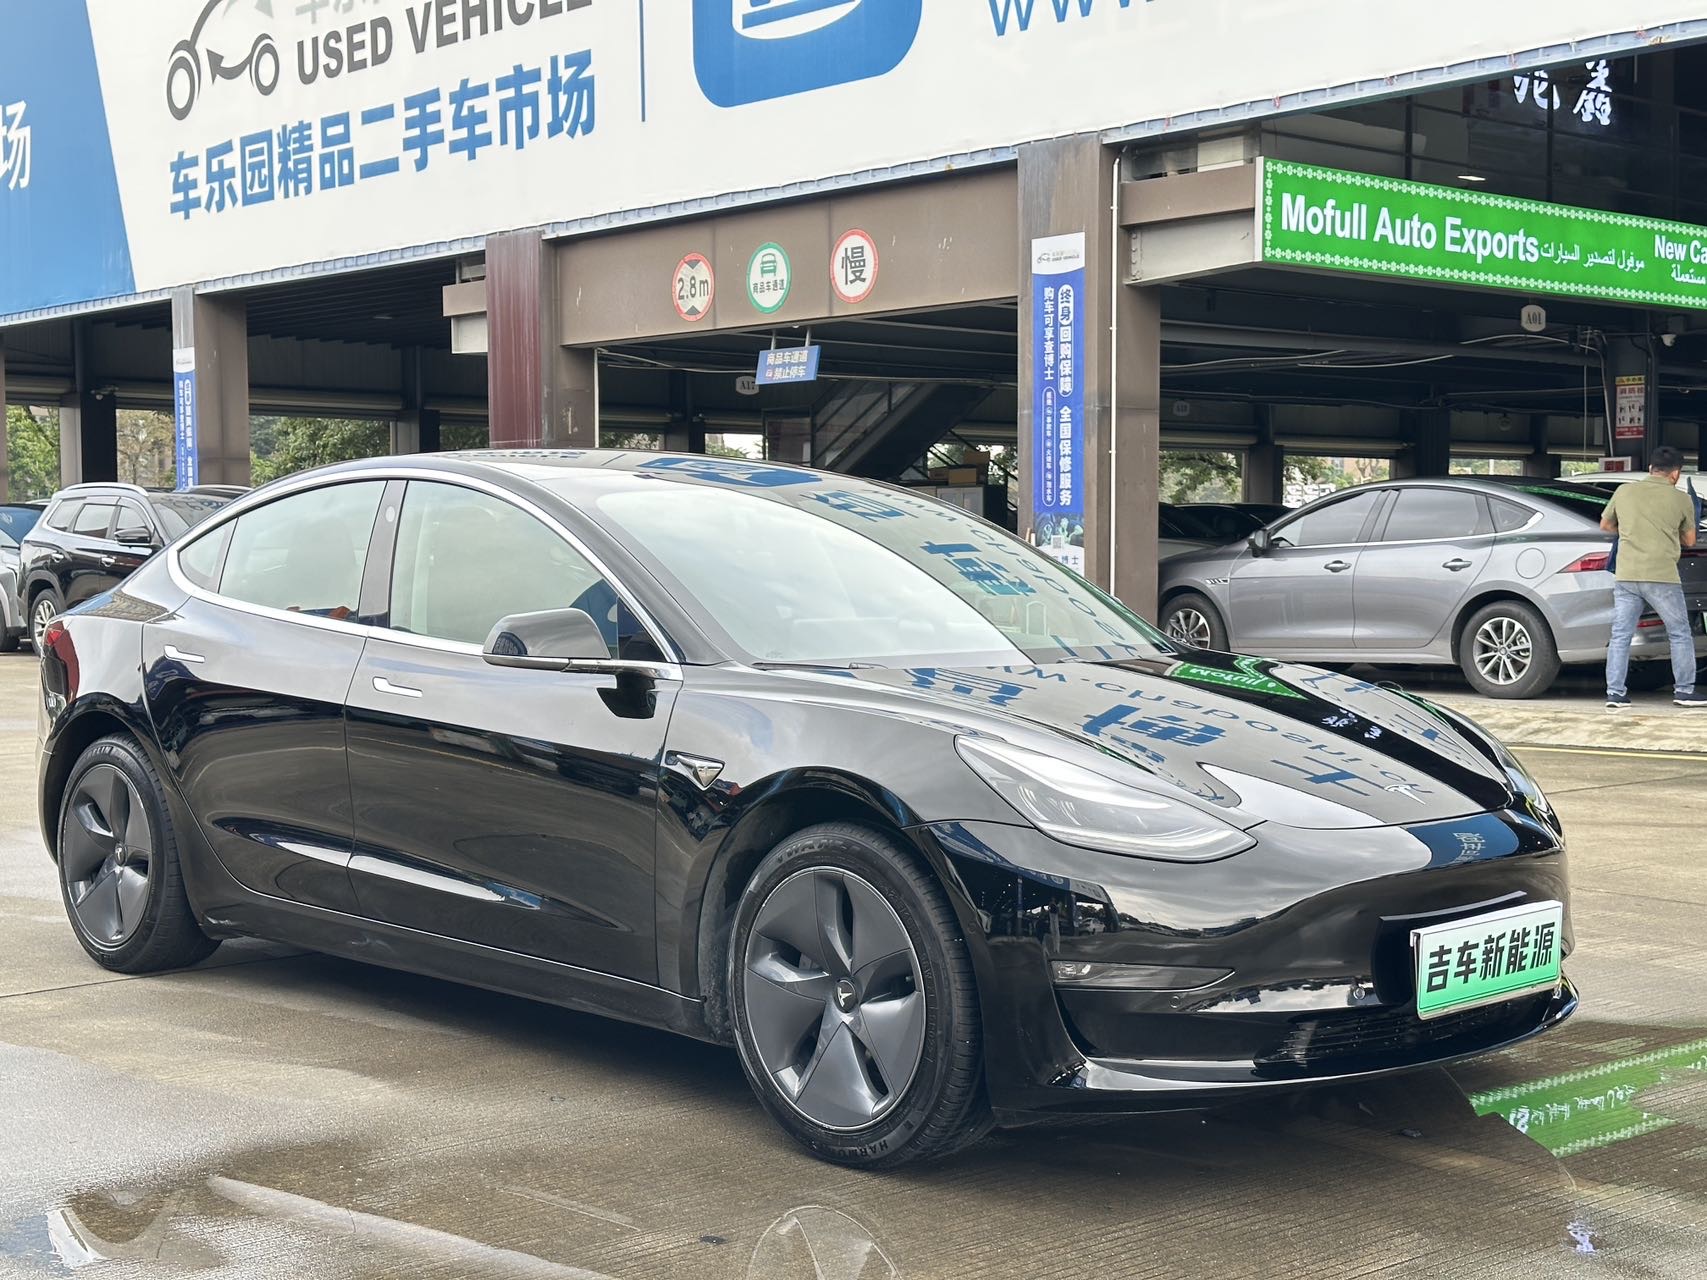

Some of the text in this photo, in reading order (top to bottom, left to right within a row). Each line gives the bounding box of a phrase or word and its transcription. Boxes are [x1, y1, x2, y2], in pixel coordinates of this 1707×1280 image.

[297, 16, 394, 85] USED
[169, 49, 596, 220] 车乐园精品二手车市场
[1281, 193, 1540, 263] Mofull Auto Exports
[1655, 234, 1687, 261] New
[841, 245, 867, 286] 慢
[1540, 242, 1580, 264] السيارات
[677, 275, 710, 300] 2.8m
[766, 350, 808, 366] 商品车通道
[773, 365, 807, 380] 禁止停车
[1059, 405, 1072, 506] 全国保修服务
[1426, 922, 1555, 993] 吉车新能源
